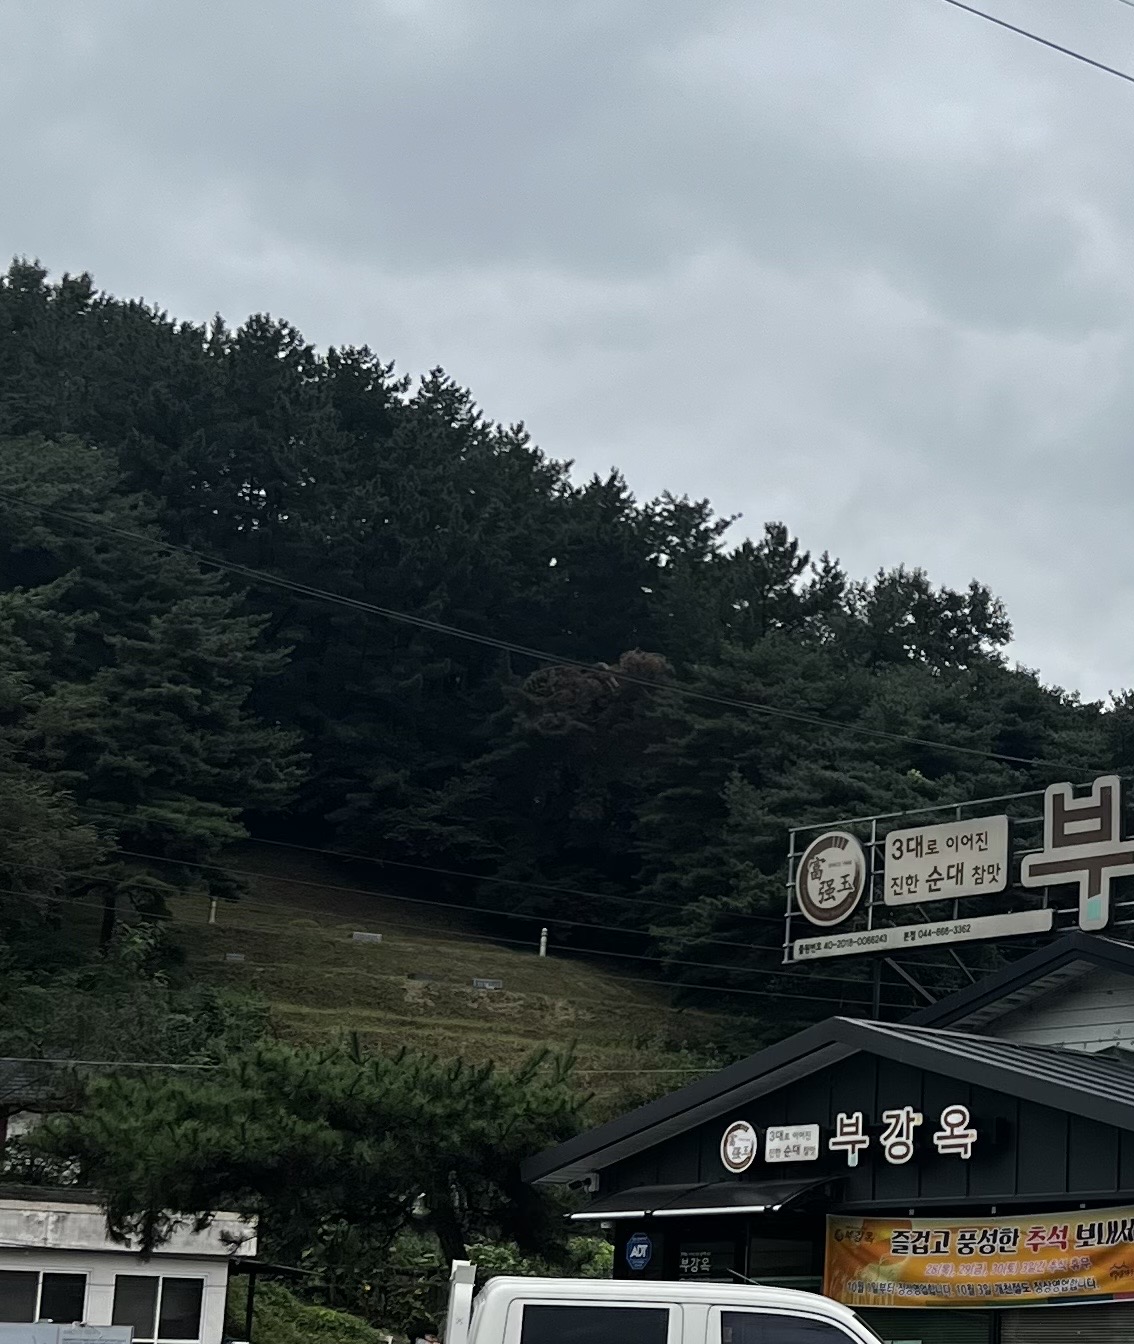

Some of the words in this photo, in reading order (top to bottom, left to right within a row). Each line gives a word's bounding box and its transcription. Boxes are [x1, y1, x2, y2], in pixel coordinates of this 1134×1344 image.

[891, 834, 940, 860] 3대로
[945, 830, 989, 853] 이어진
[890, 874, 920, 897] 진한
[925, 862, 964, 893] 순대
[971, 862, 1002, 885] 참맛
[828, 1104, 979, 1167] 부강옥
[629, 1244, 648, 1258] ADT
[890, 1229, 951, 1256] 즐겁고
[956, 1227, 1020, 1255] 풍성한
[1025, 1224, 1069, 1253] 추석
[680, 1257, 711, 1273] 부강옥
